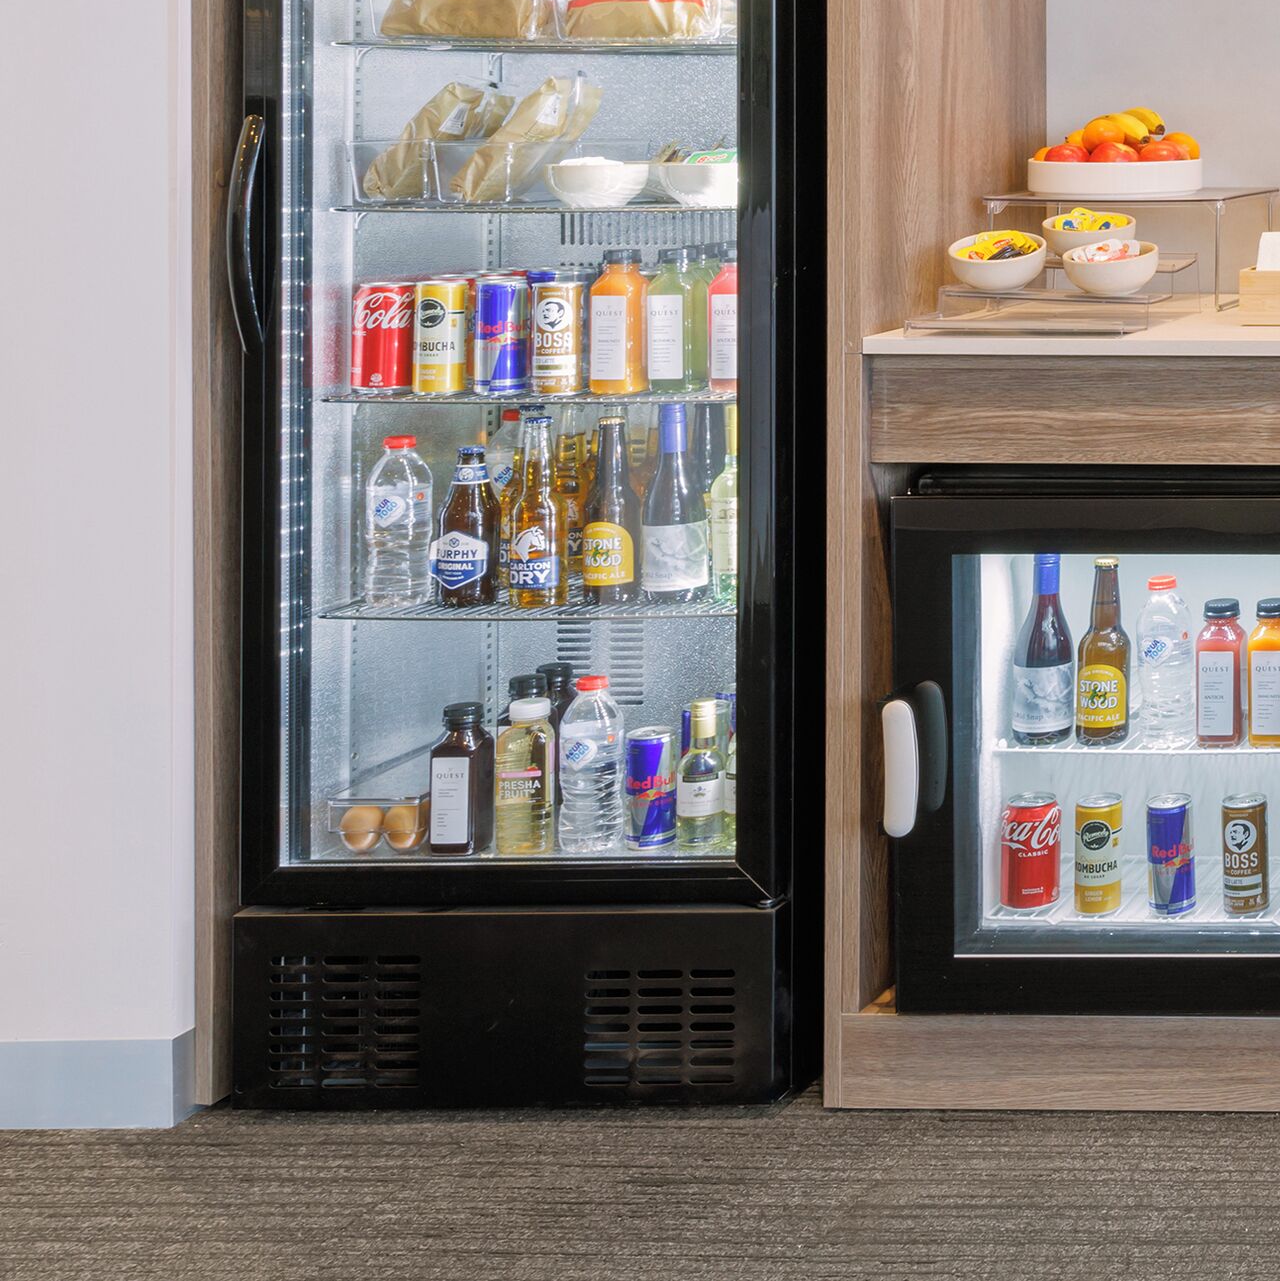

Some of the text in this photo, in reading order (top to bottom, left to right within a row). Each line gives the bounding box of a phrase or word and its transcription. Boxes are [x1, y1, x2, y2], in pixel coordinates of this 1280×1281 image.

[535, 332, 572, 352] BOSS
[584, 538, 622, 550] STONE
[437, 549, 478, 559] FURPHY
[510, 561, 551, 570] CARLTON
[510, 571, 551, 585] DRY
[1080, 680, 1118, 693] STONE
[1081, 696, 1118, 709] WOOD
[498, 780, 541, 790] PRESHA
[627, 777, 651, 790] Red
[498, 789, 532, 799] FRUIT
[1018, 849, 1049, 858] CLASSIC
[1152, 845, 1176, 857] Red
[1225, 852, 1258, 868] BOSS
